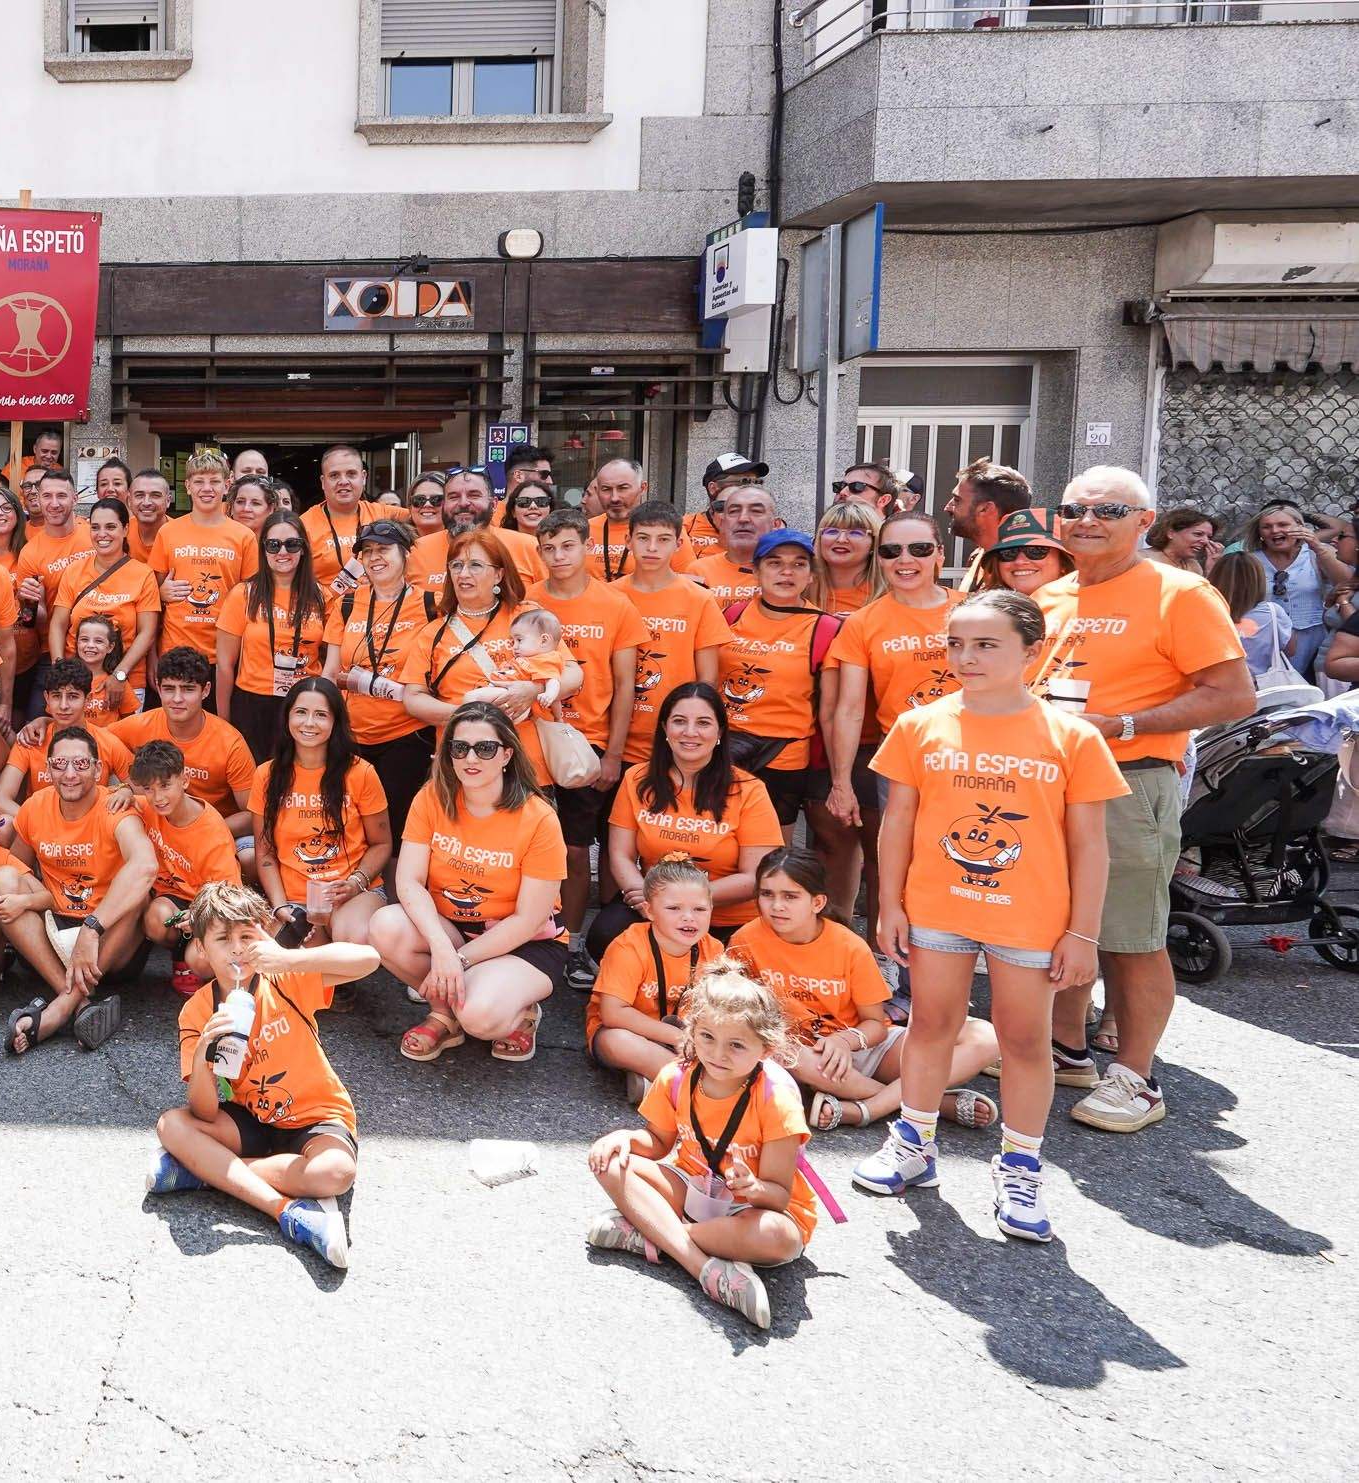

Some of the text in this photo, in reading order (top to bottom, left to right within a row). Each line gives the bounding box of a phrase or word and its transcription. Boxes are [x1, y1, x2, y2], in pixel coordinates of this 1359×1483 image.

[22, 229, 85, 254] ESPETO
[7, 256, 50, 271] MORAÑA
[711, 300, 726, 309] Estado
[49, 393, 75, 405] 2002
[1090, 433, 1108, 444] 20
[174, 545, 235, 561] PEÑA ESPETO
[428, 573, 446, 585] PE
[735, 586, 763, 598] ESP
[347, 620, 368, 634] PEÑ
[484, 638, 515, 653] ESPE
[882, 635, 922, 654] PEÑA
[923, 746, 1059, 784] PEÑA ESPETO
[37, 771, 52, 783] PE
[183, 767, 209, 780] PETO
[953, 774, 1016, 793] MORAÑA
[281, 791, 306, 809] EÑA
[298, 809, 323, 819] MORA
[637, 810, 730, 835] PEÑA ESPETO
[659, 829, 700, 844] MORAÑA
[39, 841, 94, 857] PEÑA ESPE
[431, 832, 514, 869] PEÑA ESPETO
[448, 857, 485, 878] MORAÑA
[985, 892, 1012, 905] 2025
[788, 974, 847, 997] ESPETO
[260, 1016, 290, 1043] ETO
